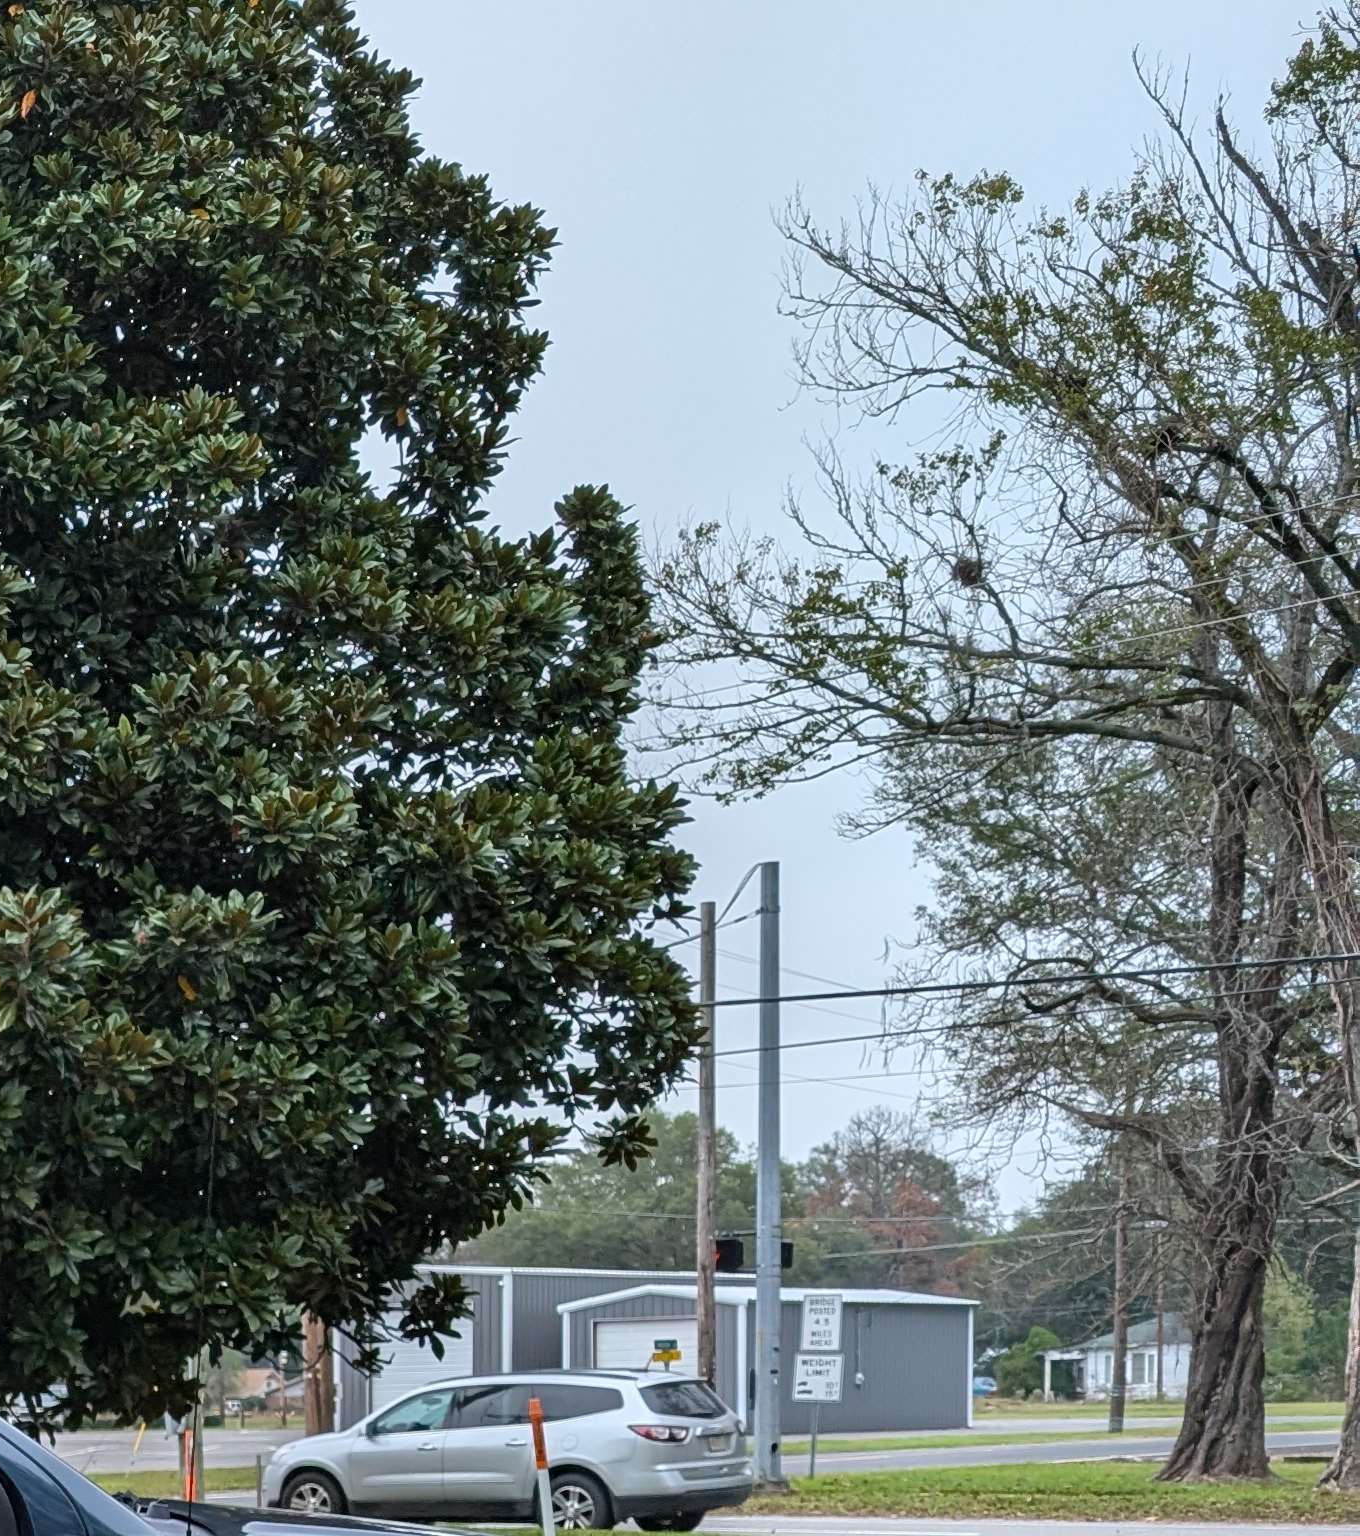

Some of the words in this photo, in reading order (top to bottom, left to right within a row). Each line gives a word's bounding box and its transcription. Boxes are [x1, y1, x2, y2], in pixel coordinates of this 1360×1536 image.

[809, 1307, 836, 1316] POSTED
[801, 1359, 838, 1368] WEIGHT
[805, 1369, 831, 1378] LIMIT
